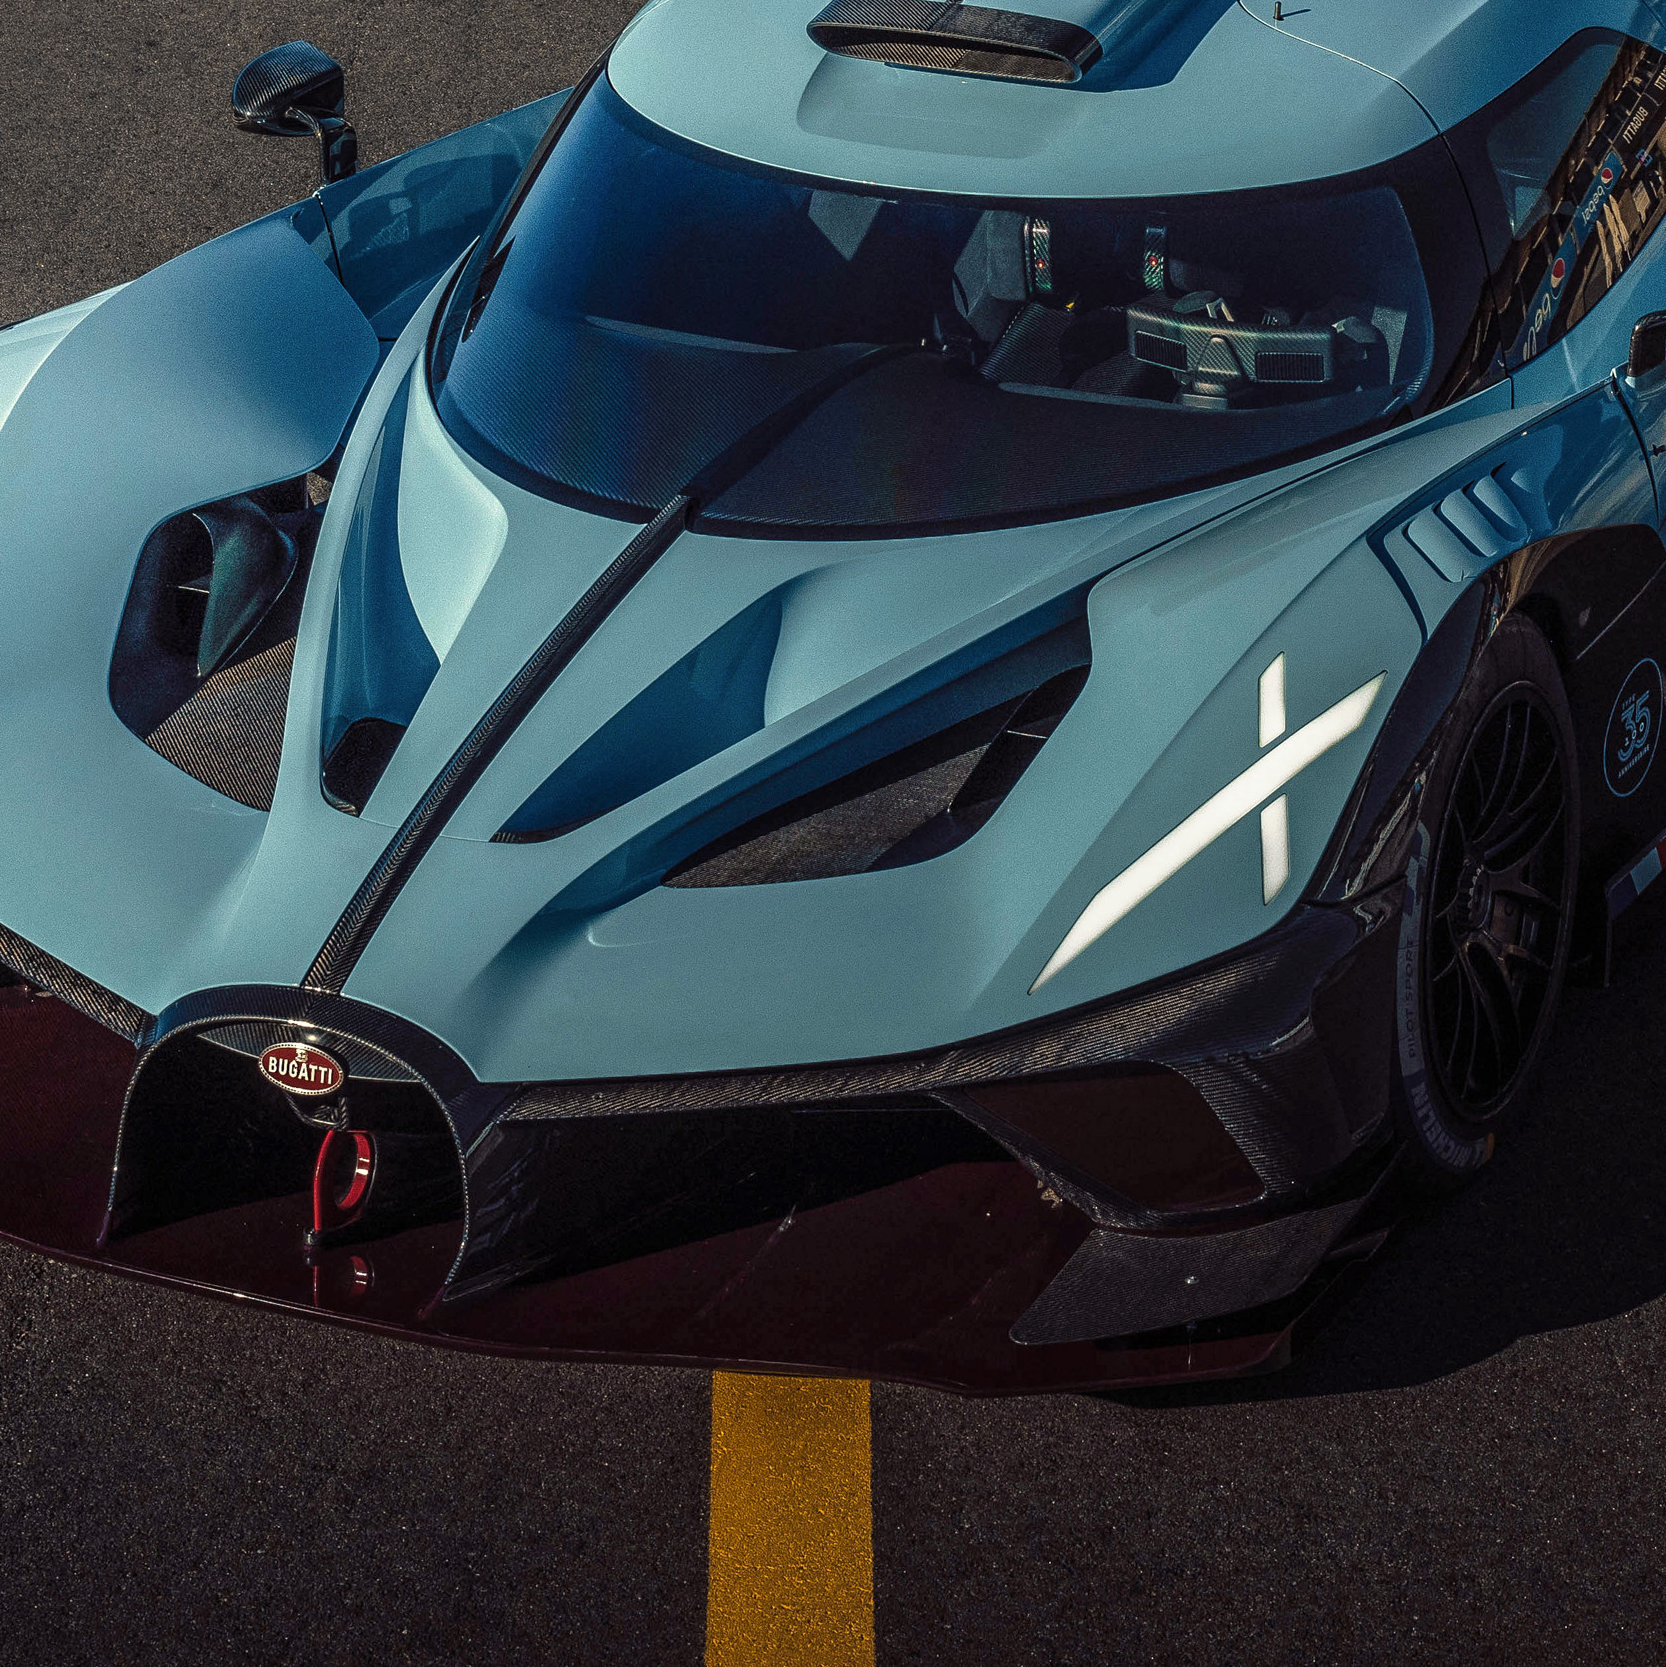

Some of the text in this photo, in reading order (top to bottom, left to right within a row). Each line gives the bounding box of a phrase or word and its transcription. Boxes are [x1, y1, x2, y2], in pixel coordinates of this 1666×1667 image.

[1617, 689, 1651, 762] 35
[1405, 939, 1416, 1058] PILOT SPORT
[268, 1056, 332, 1085] BUGATTI
[1411, 1081, 1473, 1168] MICHELIN
